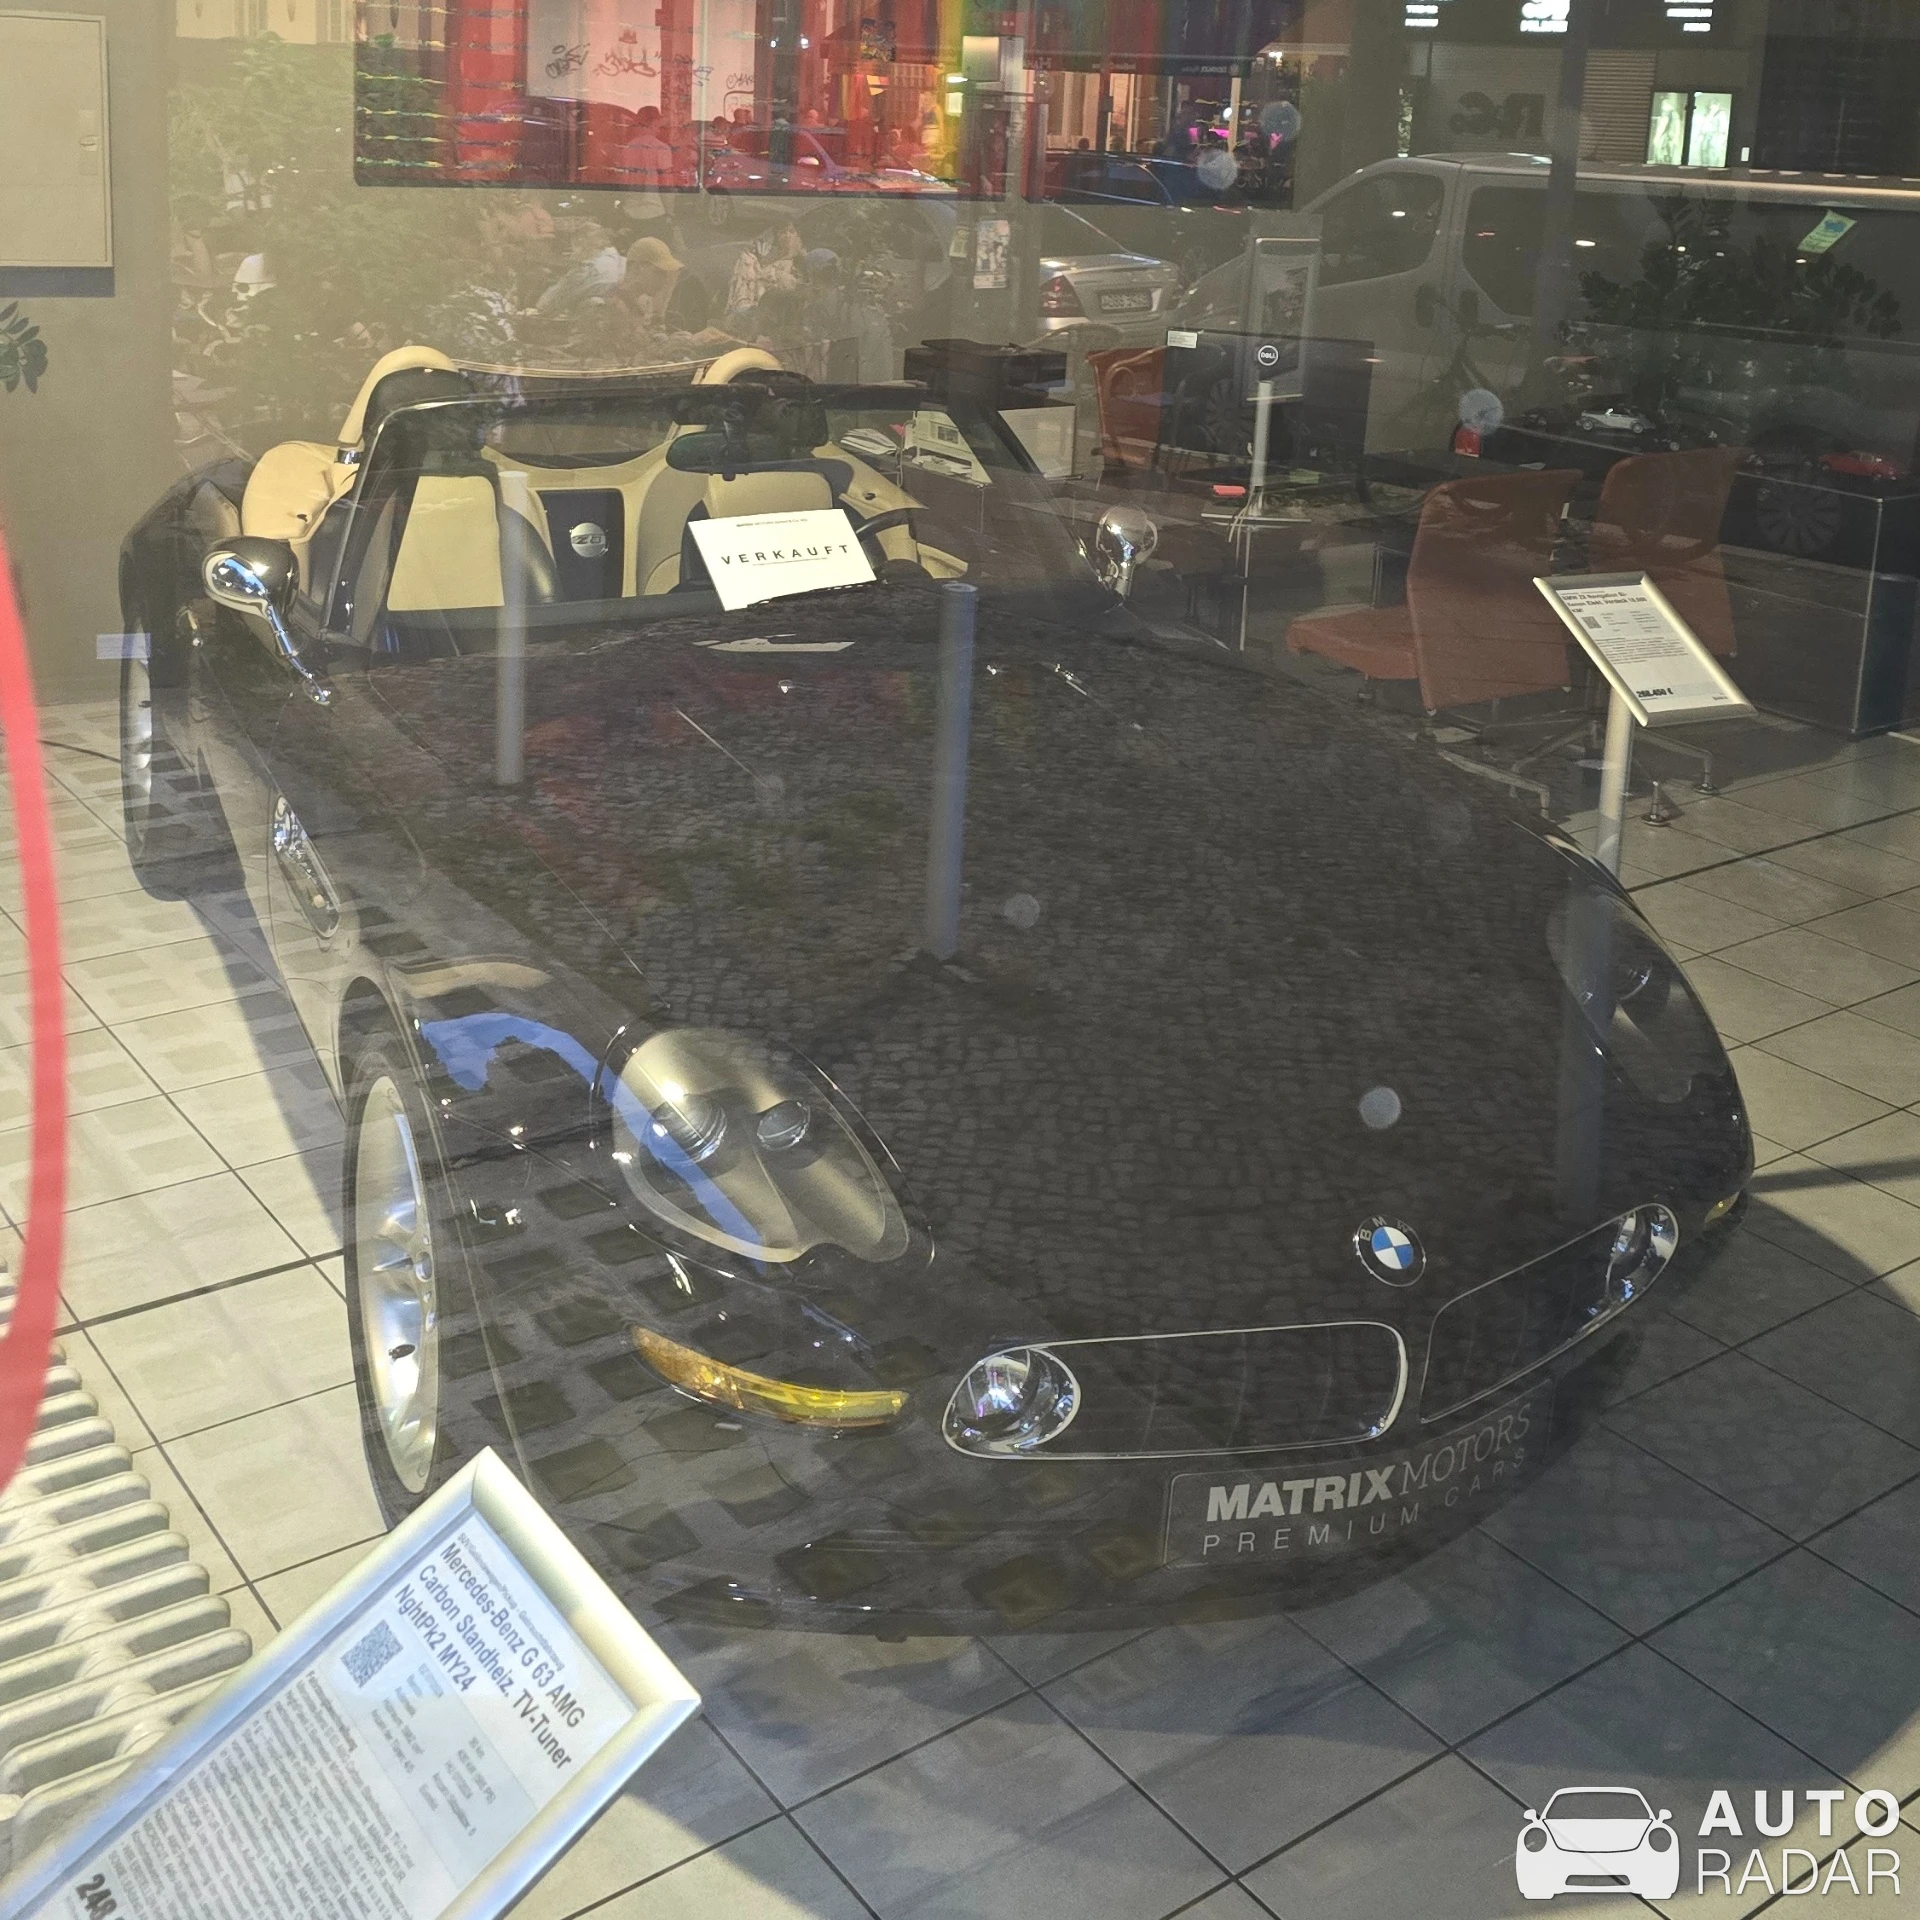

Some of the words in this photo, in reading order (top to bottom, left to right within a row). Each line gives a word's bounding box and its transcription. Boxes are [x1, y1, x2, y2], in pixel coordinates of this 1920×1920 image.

[720, 544, 848, 565] VERKAUFT
[1359, 1215, 1410, 1242] BMW
[1203, 1502, 1419, 1555] PREMIUM
[1444, 1447, 1526, 1507] CARS
[1206, 1464, 1396, 1522] MATRIX
[1399, 1402, 1531, 1496] MOTORS
[395, 1584, 446, 1650] NghtPk2
[437, 1643, 476, 1691] MY24
[420, 1565, 460, 1620] Carbon
[457, 1615, 514, 1697] Standheiz.
[513, 1689, 571, 1769] TV-Tuner
[440, 1543, 524, 1653] Mercedes-Benz
[522, 1648, 539, 1666] G
[532, 1662, 554, 1687] 63
[546, 1685, 585, 1727] AMG
[75, 1873, 126, 1920] 248
